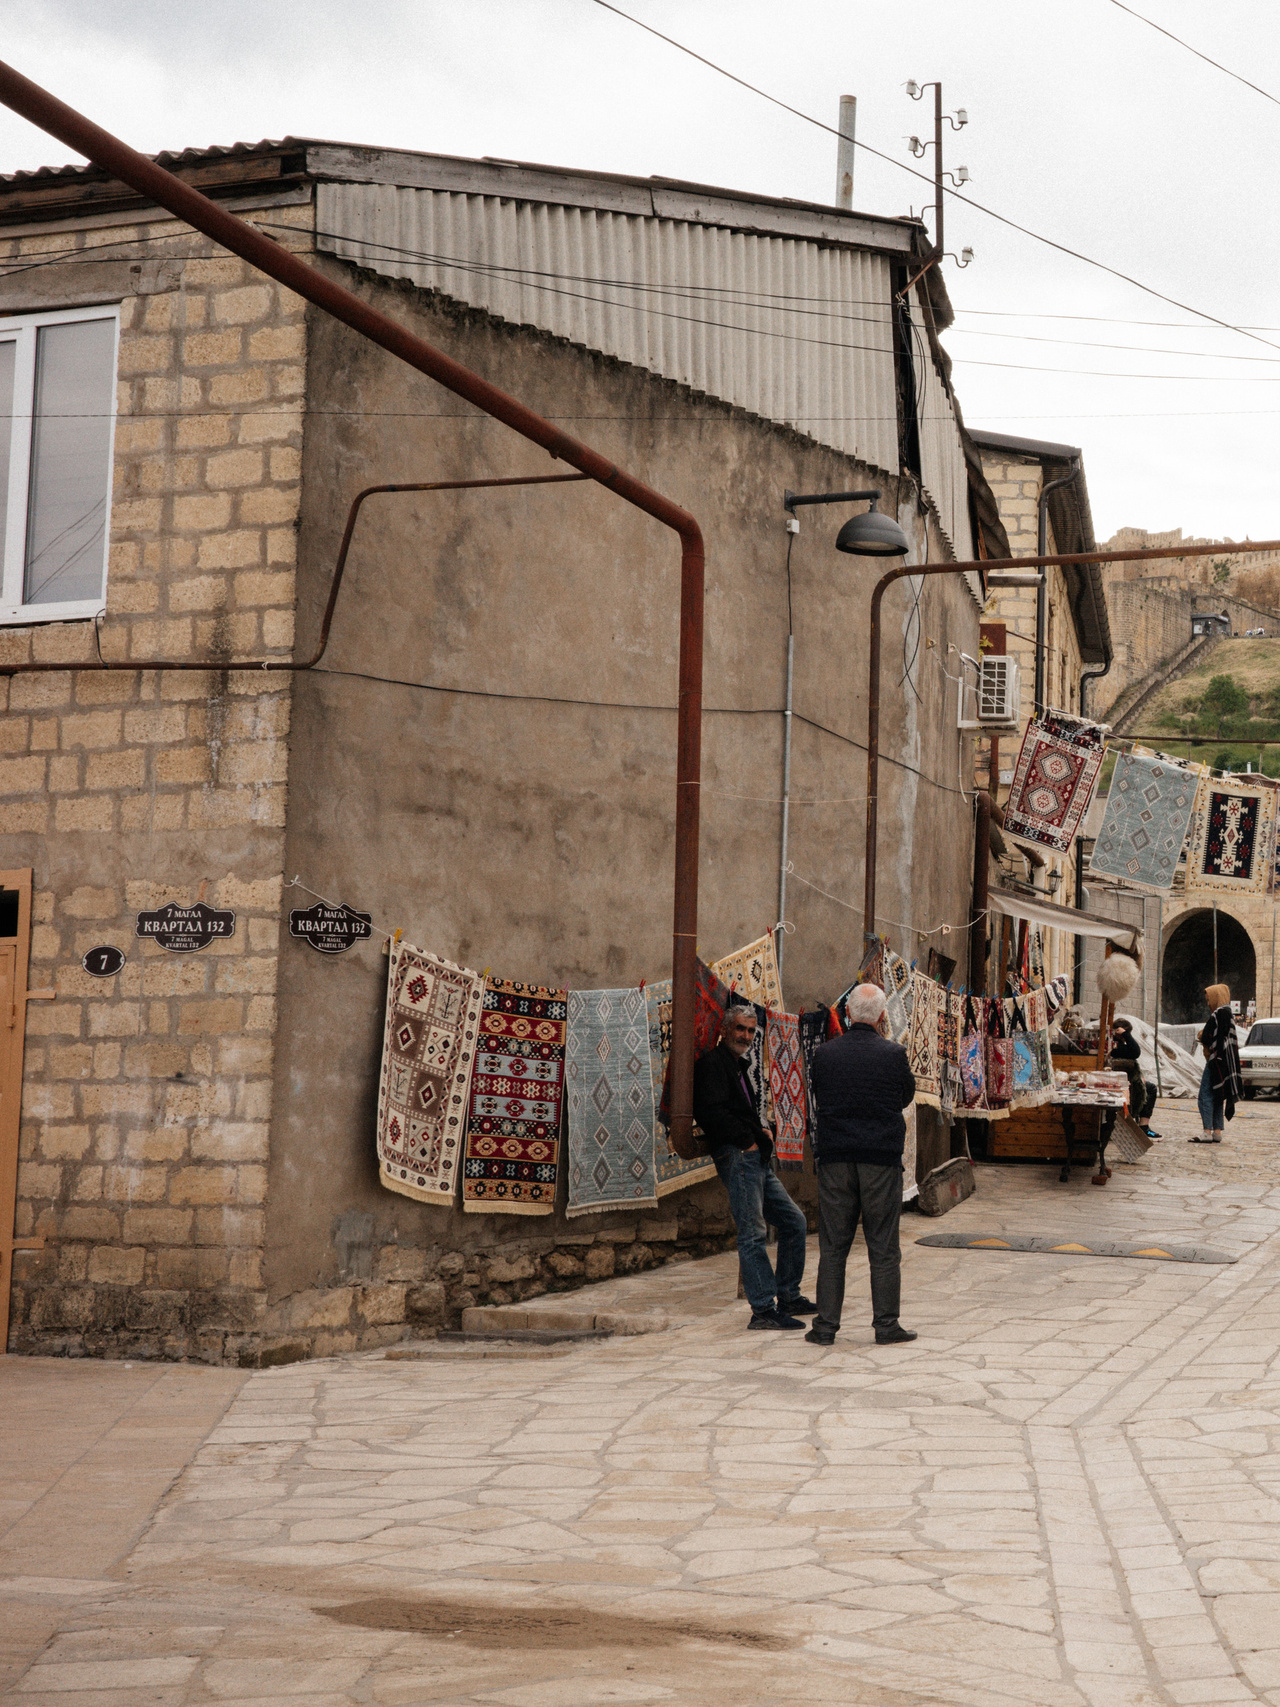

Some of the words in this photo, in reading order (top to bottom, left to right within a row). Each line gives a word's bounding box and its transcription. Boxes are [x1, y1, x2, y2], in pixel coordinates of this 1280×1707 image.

[167, 908, 173, 918] 7
[174, 910, 202, 918] МАГАЛ
[317, 908, 323, 918] 7
[324, 910, 347, 919] МАГАЛ
[144, 921, 203, 932] КВАРТАЛ
[207, 921, 224, 932] 132
[298, 920, 348, 933] КВАРТАЛ
[351, 922, 365, 934] 132
[100, 954, 108, 970] 7
